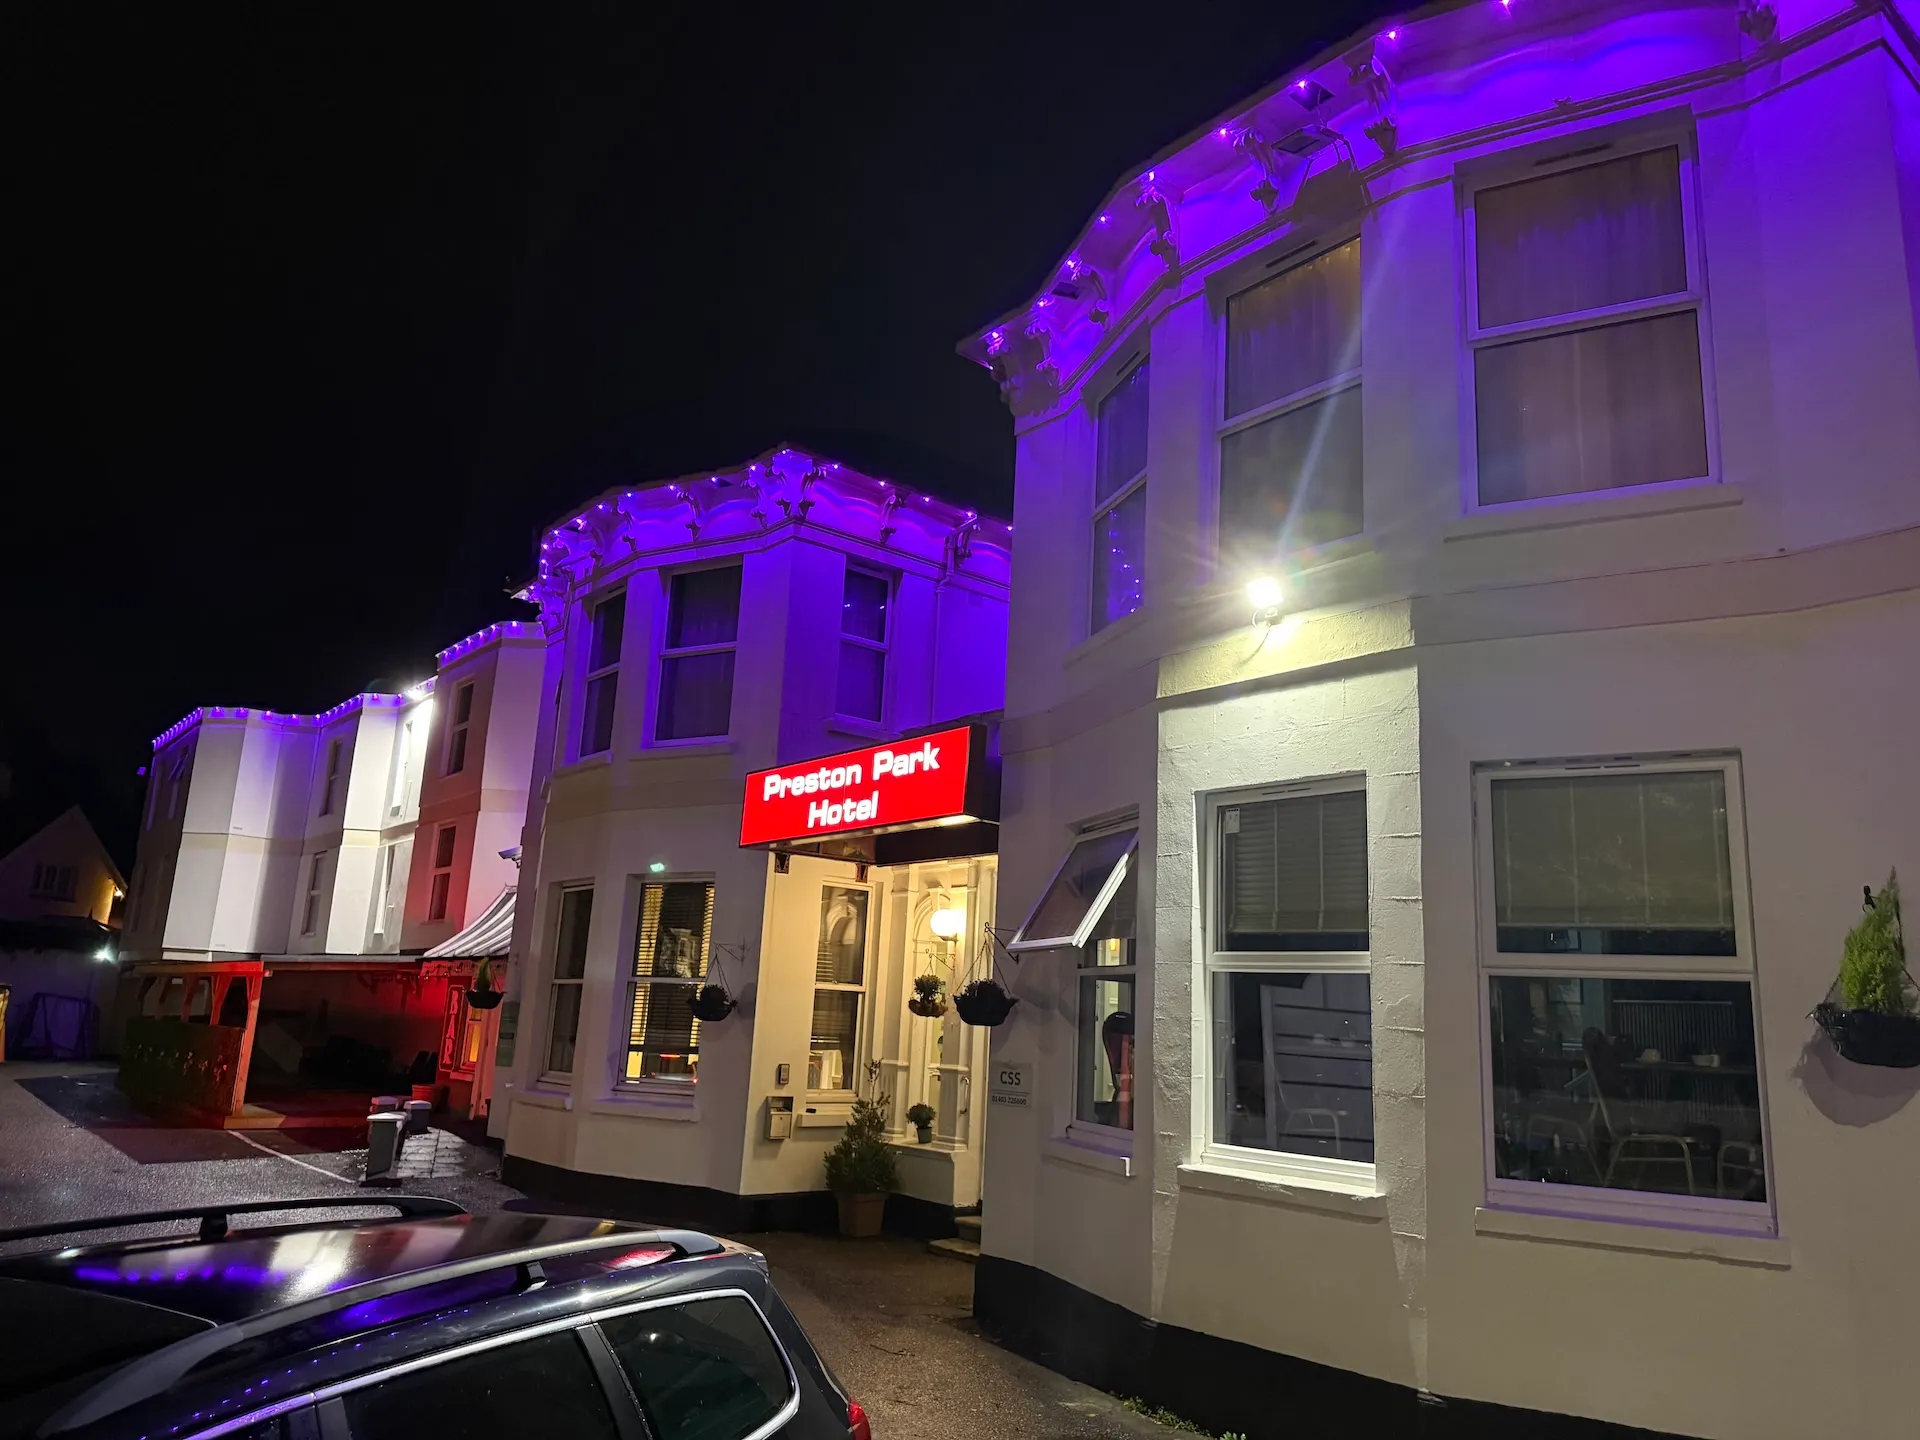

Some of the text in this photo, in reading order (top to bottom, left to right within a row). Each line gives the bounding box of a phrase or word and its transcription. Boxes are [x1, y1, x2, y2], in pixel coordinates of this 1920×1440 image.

[763, 742, 941, 801] Preston Park
[807, 790, 879, 828] Hotel
[442, 990, 459, 1065] BAR
[1000, 1071, 1021, 1086] CSS
